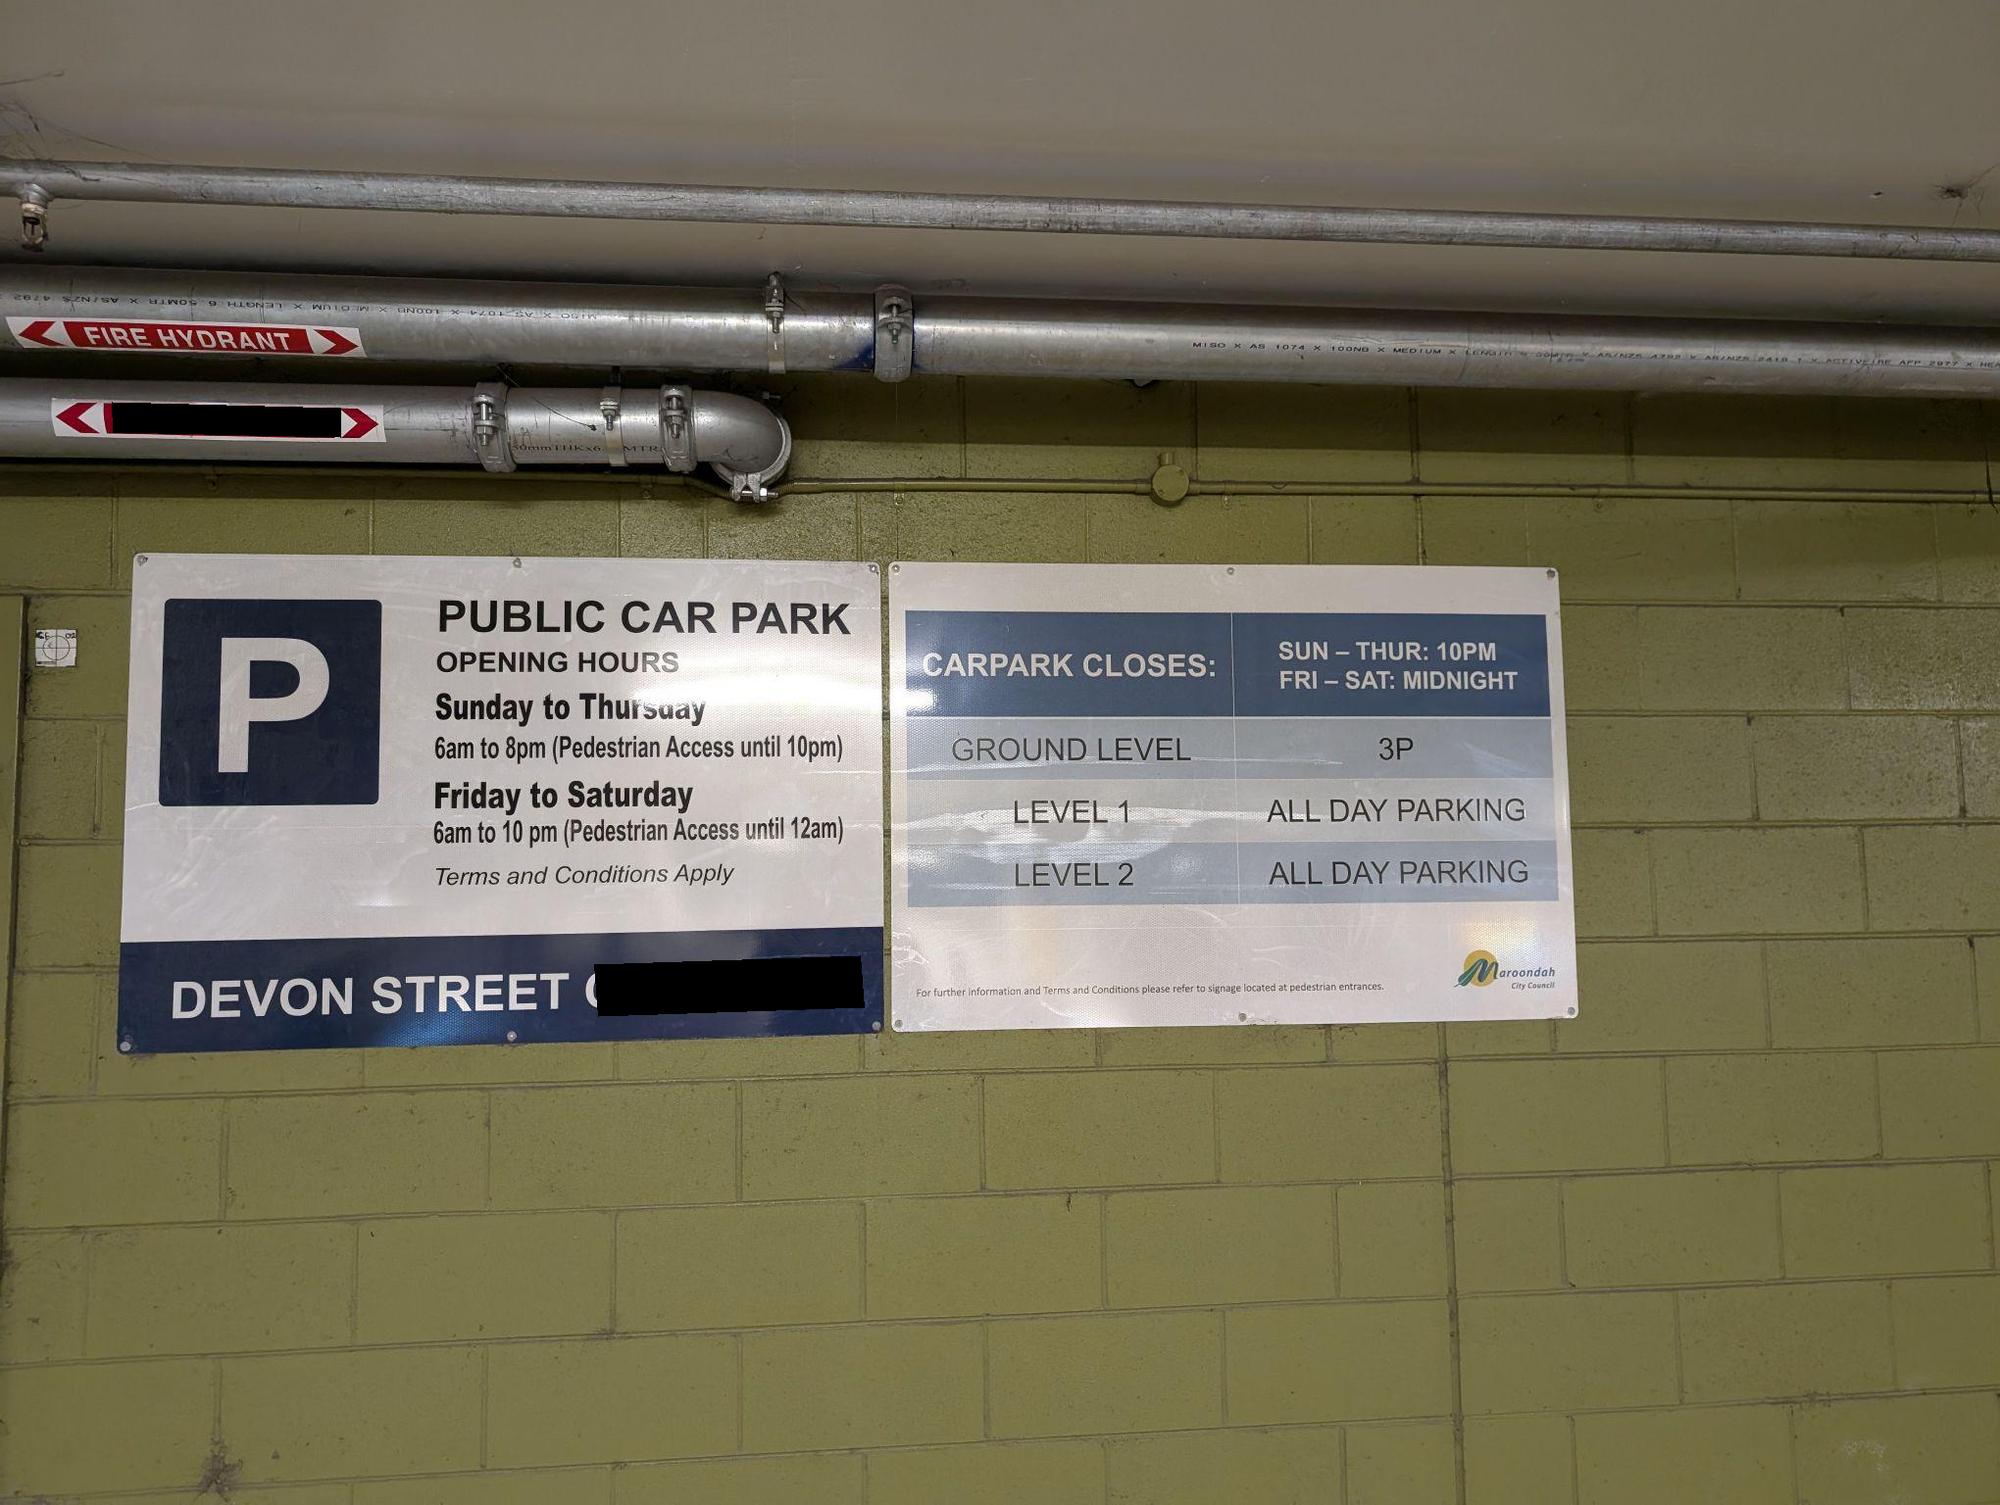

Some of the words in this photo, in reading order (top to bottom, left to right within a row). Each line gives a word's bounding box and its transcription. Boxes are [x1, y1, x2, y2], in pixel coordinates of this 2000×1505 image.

[227, 301, 282, 309] LENGTH
[312, 304, 370, 312] MEDIUM
[82, 326, 152, 347] FIRE
[156, 328, 290, 351] HYDRANT
[1393, 347, 1441, 355] MEDIUM
[439, 600, 605, 633] PUBLIC
[621, 600, 717, 634] CAR
[732, 602, 851, 635] PARK
[436, 651, 568, 673] OPENING
[578, 651, 679, 673] HOURS
[1278, 641, 1328, 661] SUN
[1356, 641, 1429, 661] THUR:
[1437, 642, 1496, 661] 10PM
[923, 653, 1074, 677] CARPARK
[1082, 653, 1216, 677] CLOSES:
[1279, 670, 1318, 690] FRI
[1345, 670, 1395, 690] SAT:
[1403, 671, 1518, 690] MIDNIGHT
[218, 637, 330, 773] P
[435, 693, 533, 727] Sunday
[543, 694, 570, 720] to
[580, 693, 706, 726] Thursday
[434, 737, 475, 760] 6am
[480, 738, 499, 759] to
[505, 737, 546, 764] 8pm
[552, 735, 660, 764] (Pedestrian
[665, 735, 734, 758] Access
[740, 735, 781, 757] until
[787, 734, 842, 762] 10pm)
[952, 738, 1087, 761] GROUND
[1098, 738, 1191, 761] LEVEL
[1378, 737, 1413, 761] 3P
[434, 781, 521, 815] Friday
[530, 783, 557, 808] to
[567, 780, 693, 814] Saturday
[1014, 800, 1108, 823] LEVEL
[1117, 800, 1129, 823] 1
[1267, 799, 1321, 822] ALL
[1330, 799, 1388, 822] DAY
[1397, 798, 1527, 822] PARKING
[433, 821, 472, 844] 6am
[477, 821, 496, 843] to
[501, 820, 523, 842] 10
[529, 825, 557, 848] pm
[564, 818, 668, 847] (Pedestrian
[673, 817, 739, 840] Access
[745, 816, 784, 840] until
[791, 816, 843, 844] 12am)
[436, 867, 500, 885] Terms
[507, 867, 547, 884] and
[555, 864, 668, 884] Conditions
[674, 863, 734, 886] Apply
[1015, 863, 1109, 886] LEVEL
[1118, 863, 1134, 886] 2
[1269, 861, 1323, 885] ALL
[1332, 861, 1389, 884] DAY
[1400, 860, 1528, 884] PARKING
[1455, 958, 1556, 987] Maroondah
[172, 977, 353, 1019] DEVON
[371, 972, 569, 1014] STREET
[916, 988, 931, 997] For
[933, 987, 966, 997] further
[968, 987, 1022, 996] information
[1024, 986, 1041, 995] and
[1043, 986, 1070, 995] Terms
[1072, 986, 1089, 995] and
[1091, 984, 1139, 994] Conditions
[1141, 984, 1171, 995] please
[1172, 984, 1194, 993] refer
[1196, 984, 1206, 993] to
[1207, 984, 1241, 995] signage
[1243, 983, 1276, 992] located
[1278, 984, 1287, 992] at
[1289, 982, 1336, 994] pedestrian
[1338, 982, 1384, 992] entrances.
[1511, 982, 1526, 991] City
